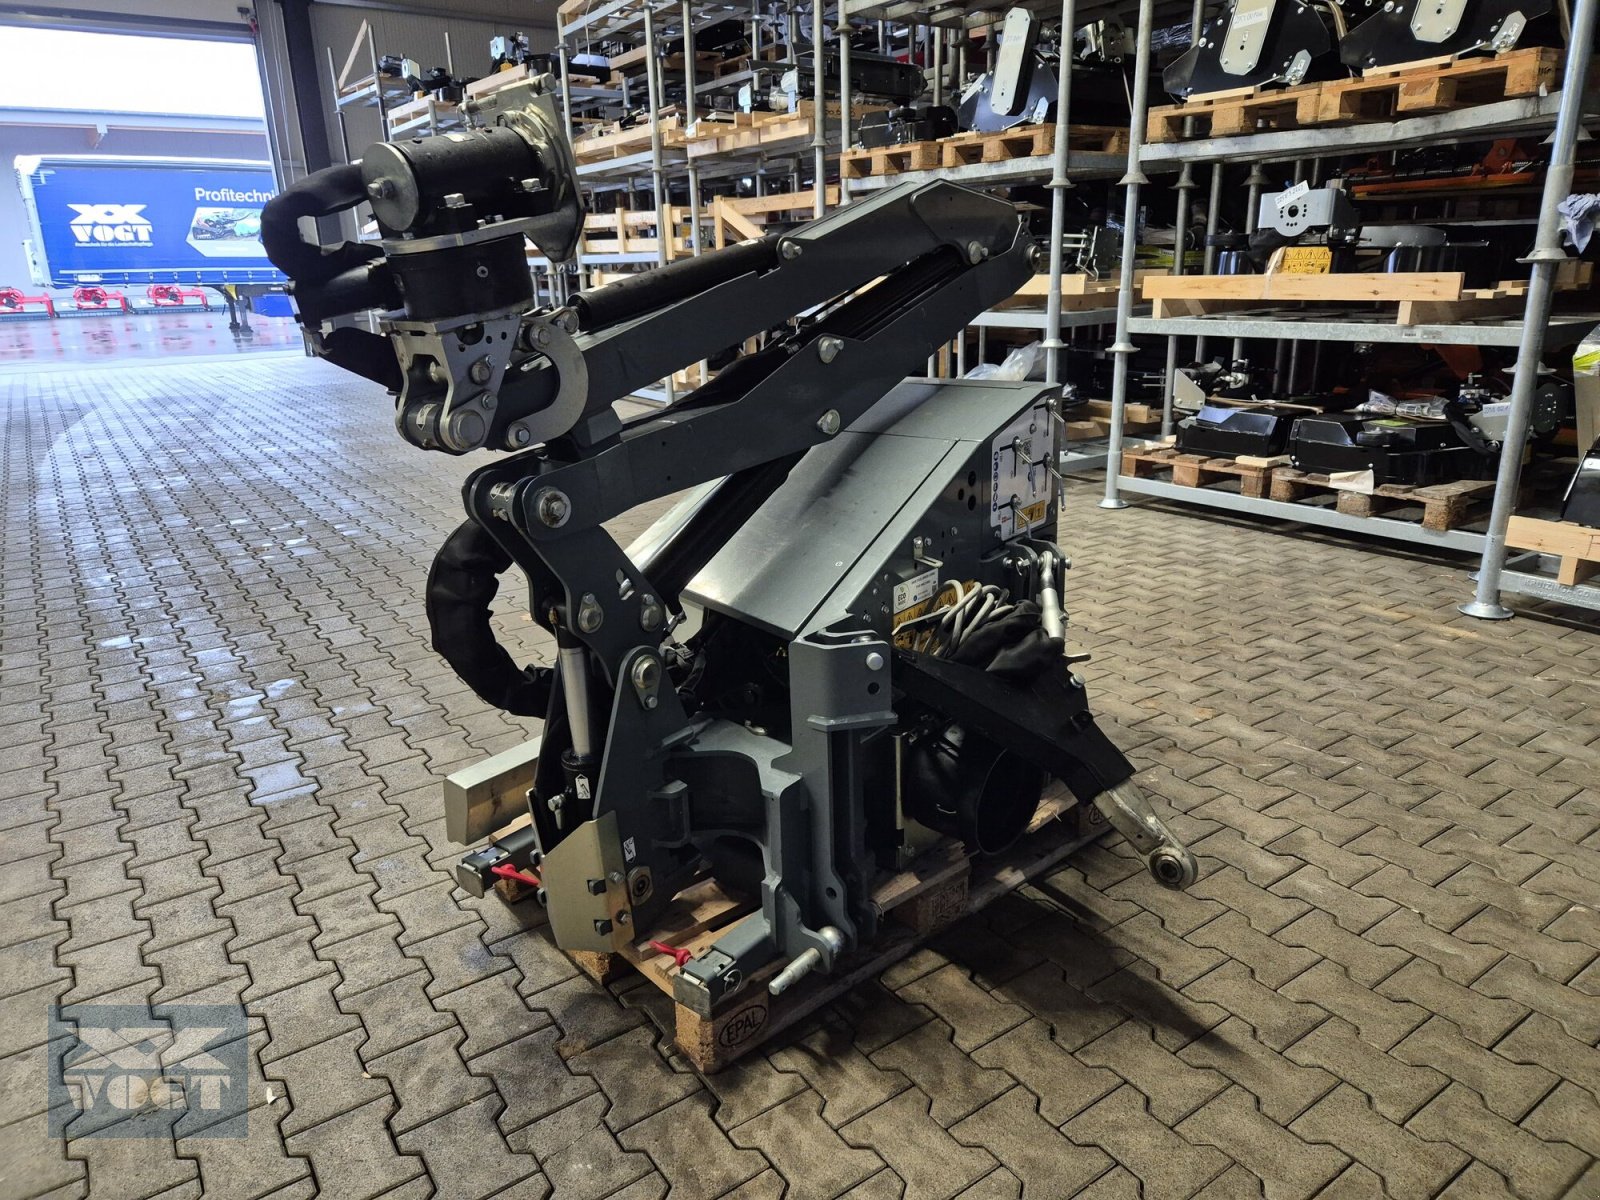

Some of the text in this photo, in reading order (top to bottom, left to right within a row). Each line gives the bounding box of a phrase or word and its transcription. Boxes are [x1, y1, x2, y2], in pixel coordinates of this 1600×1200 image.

[194, 187, 276, 203] Profitechni
[70, 225, 153, 242] VOGT
[727, 1010, 761, 1044] EPAL
